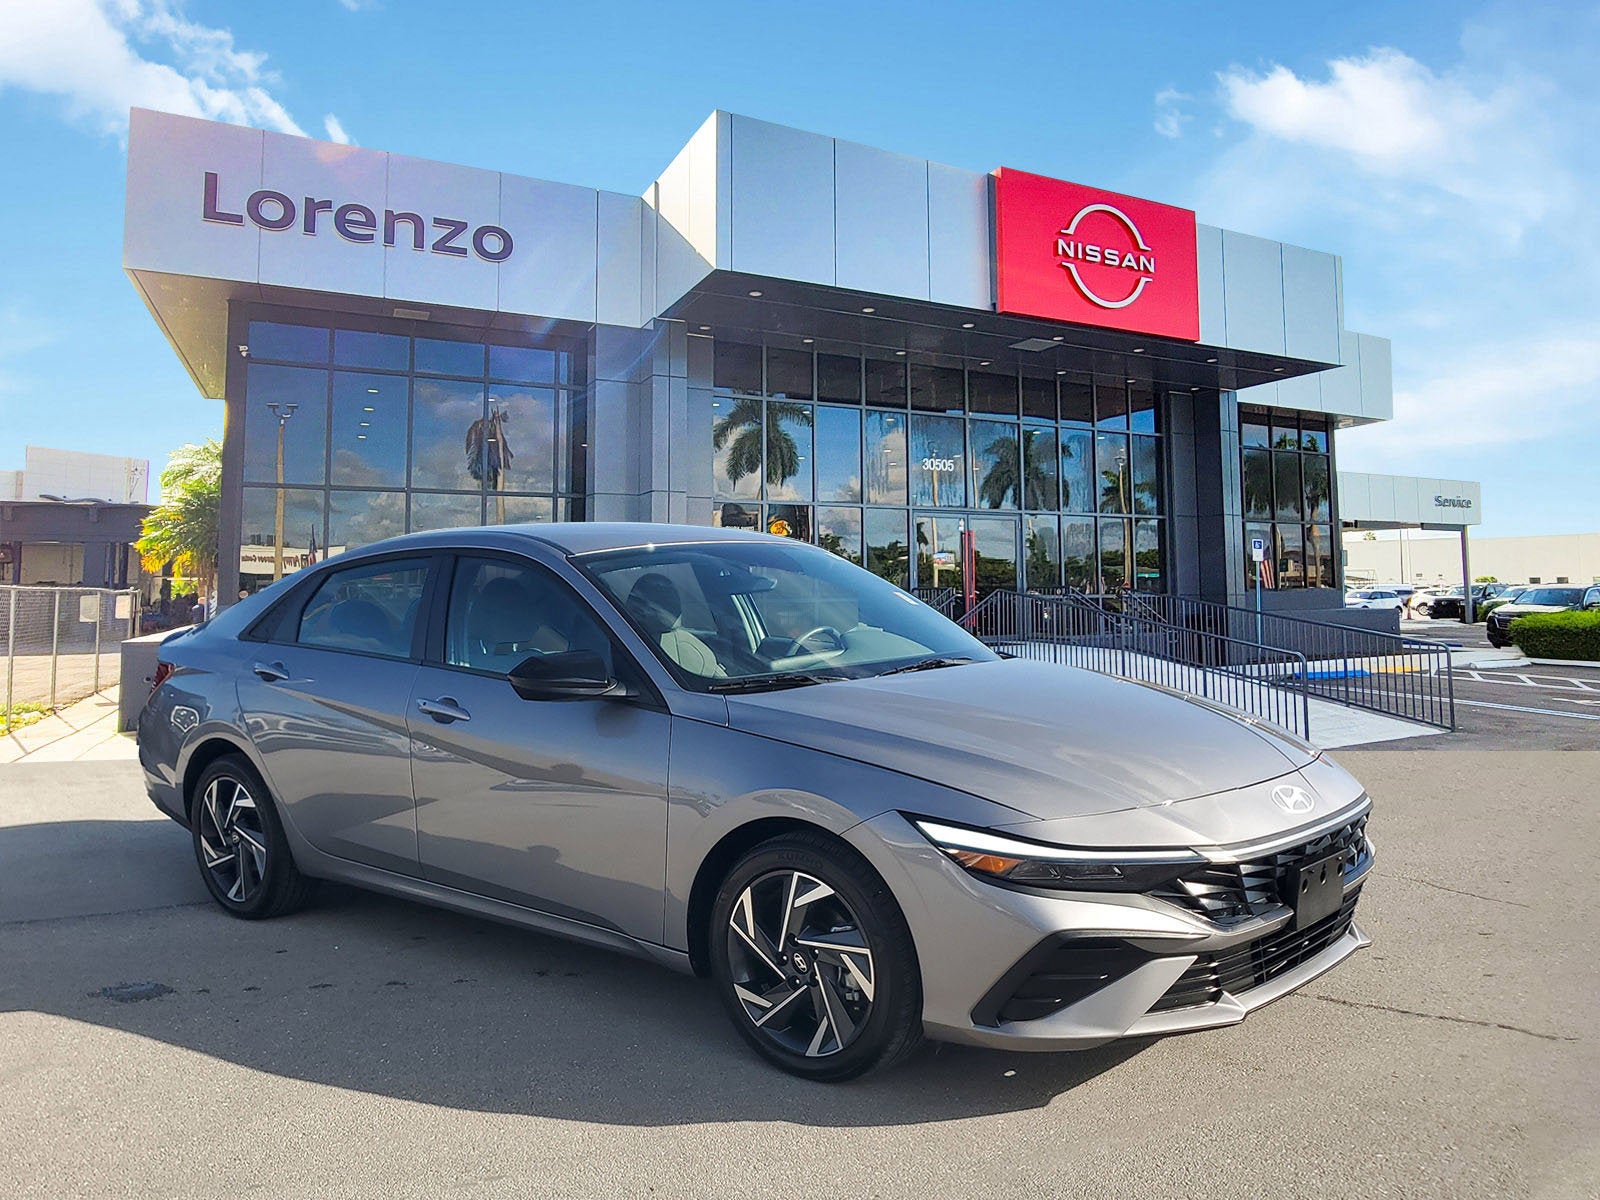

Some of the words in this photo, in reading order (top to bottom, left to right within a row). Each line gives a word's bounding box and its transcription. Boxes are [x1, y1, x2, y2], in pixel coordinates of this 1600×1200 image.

[203, 171, 514, 262] Lorenzo
[1057, 238, 1155, 273] NISSAN
[922, 457, 955, 472] 30505
[1434, 495, 1472, 509] Service
